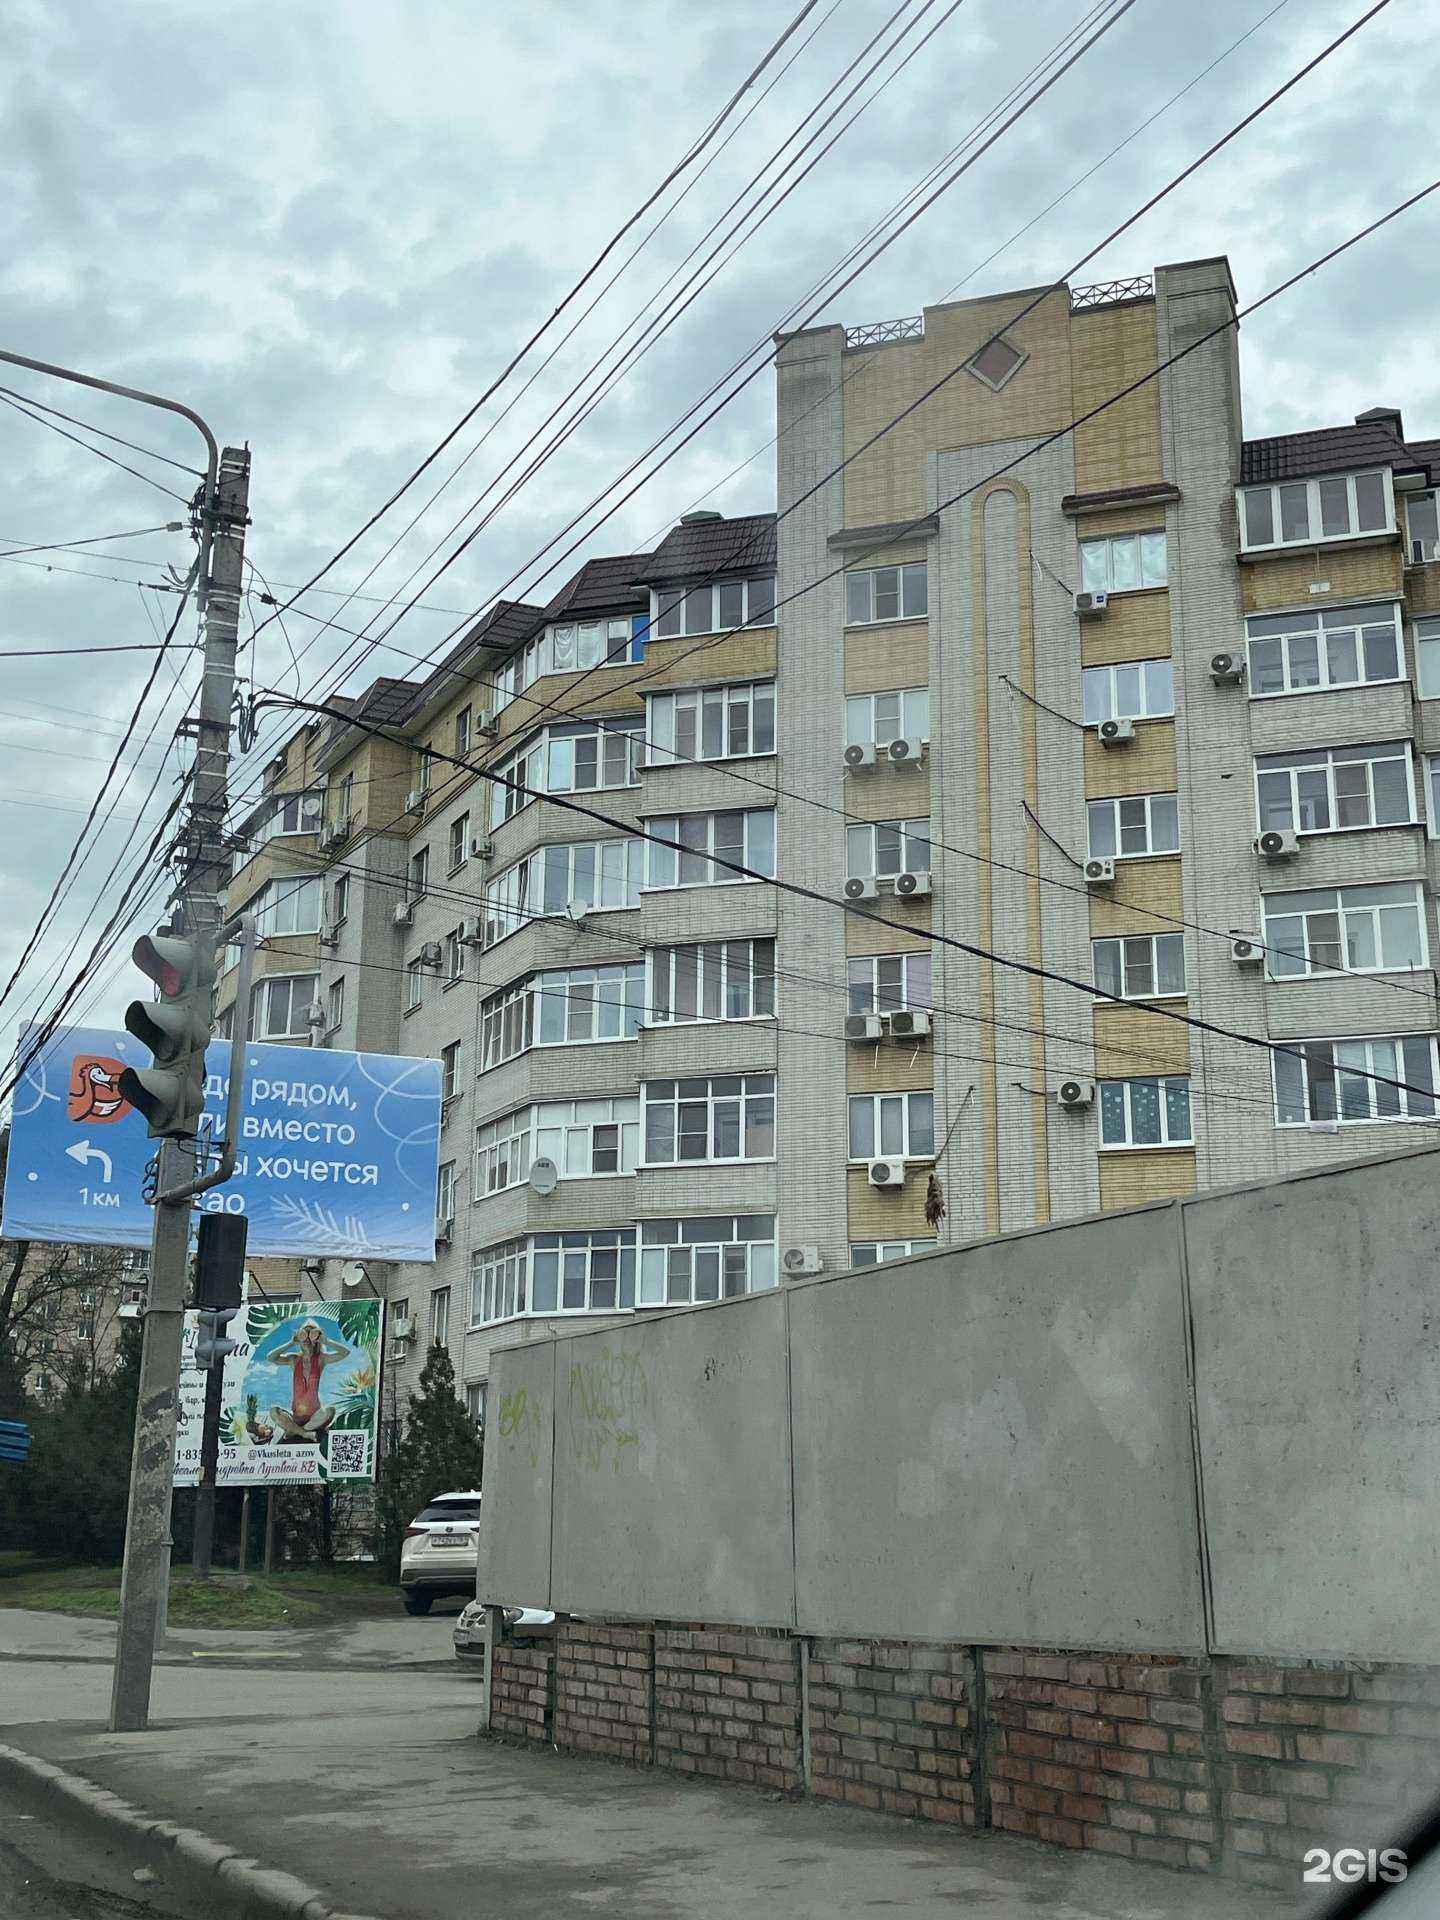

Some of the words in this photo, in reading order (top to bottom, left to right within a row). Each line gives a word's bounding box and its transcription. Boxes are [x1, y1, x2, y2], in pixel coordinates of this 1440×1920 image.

[251, 1078, 357, 1112] рядом,
[243, 1116, 355, 1145] вместо
[256, 1156, 379, 1186] хочется
[80, 1187, 88, 1205] 1
[93, 1192, 120, 1208] км
